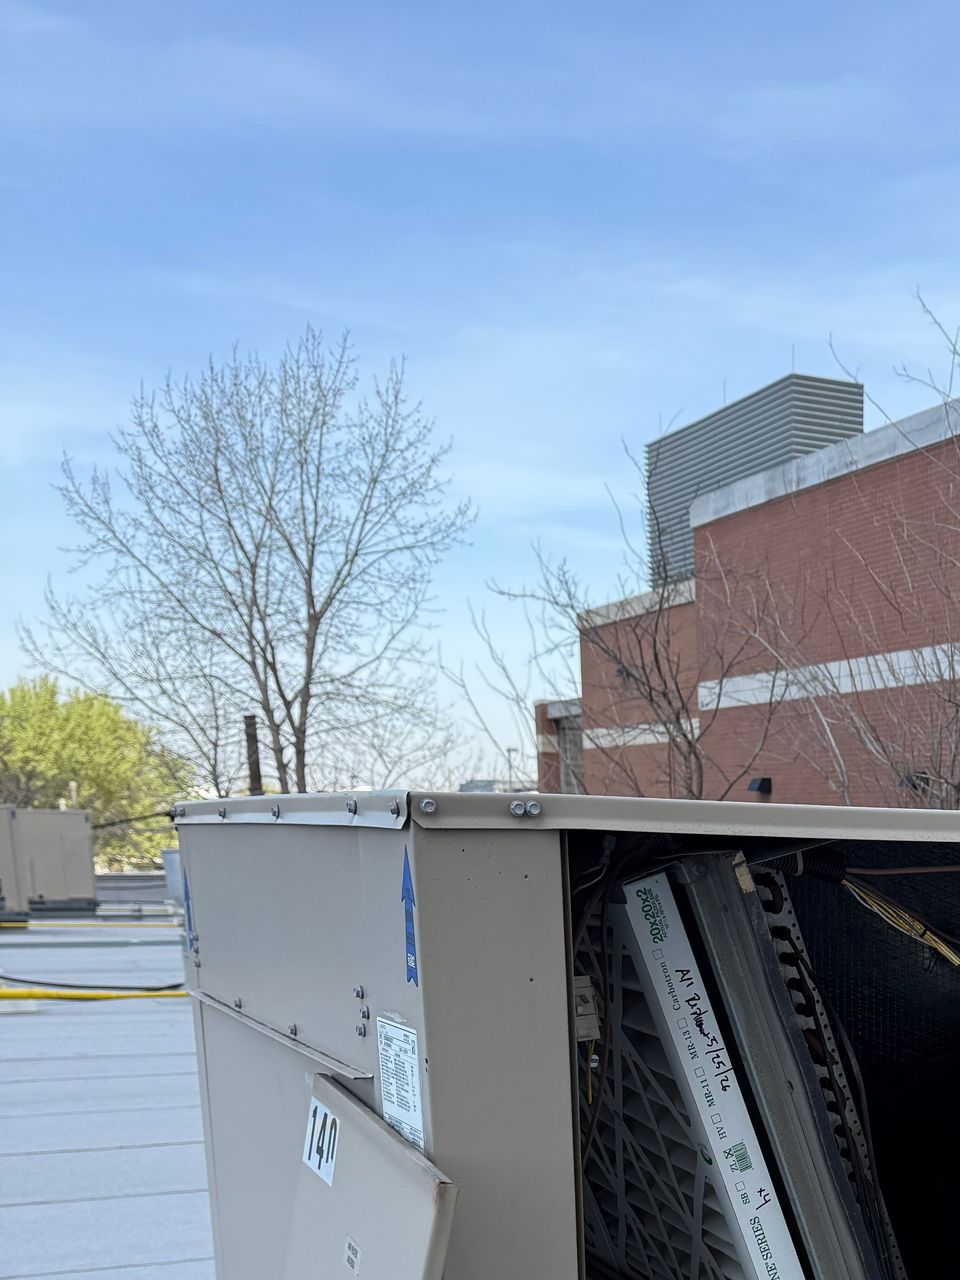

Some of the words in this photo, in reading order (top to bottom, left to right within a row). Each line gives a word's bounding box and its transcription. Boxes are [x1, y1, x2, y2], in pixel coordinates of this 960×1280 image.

[636, 888, 664, 944] 20x20x2
[660, 961, 681, 1011] Carbotron
[682, 1026, 699, 1061] MR-13
[700, 1078, 716, 1108] MR-11
[715, 1126, 727, 1140] HV
[740, 1191, 751, 1205] SB
[750, 1215, 773, 1261] SERIES
